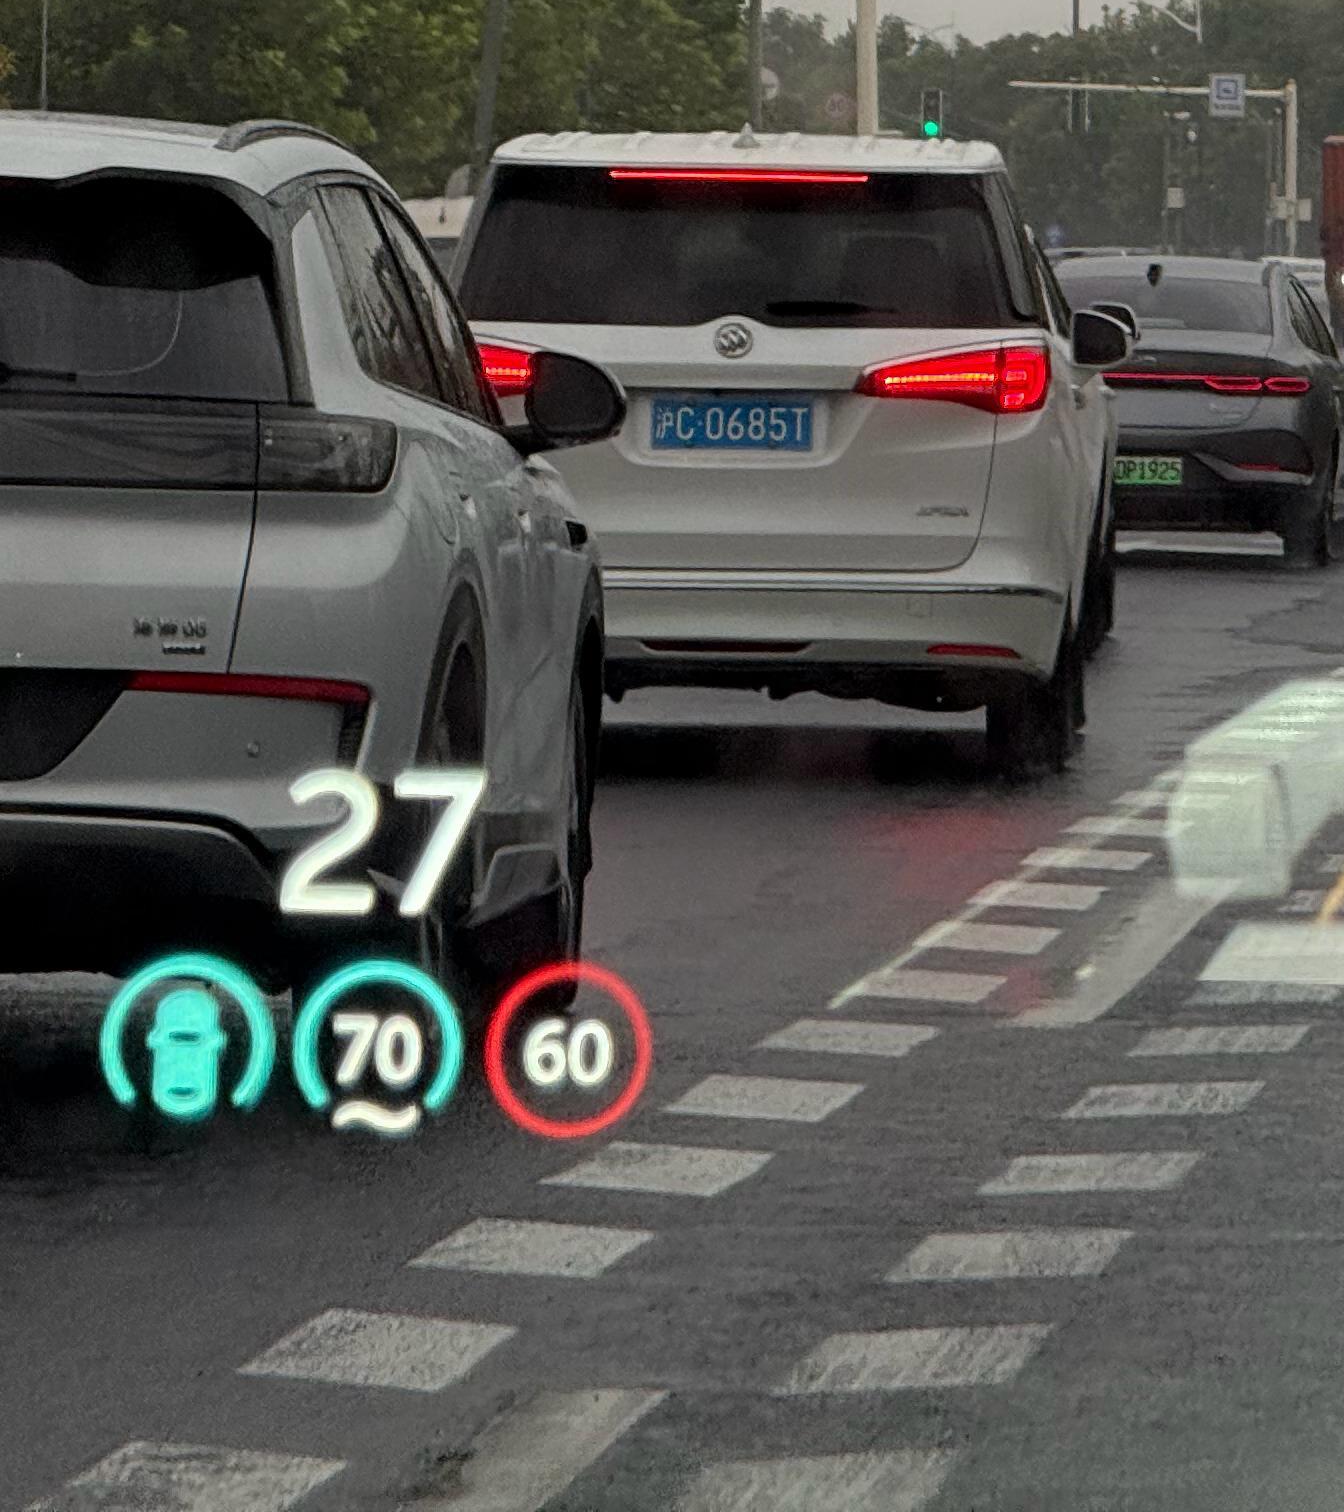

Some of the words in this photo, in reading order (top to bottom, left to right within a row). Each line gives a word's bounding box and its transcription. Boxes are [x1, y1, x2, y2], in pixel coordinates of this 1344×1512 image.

[279, 768, 488, 915] 27
[331, 1014, 423, 1087] 70
[522, 1019, 613, 1086] 60
